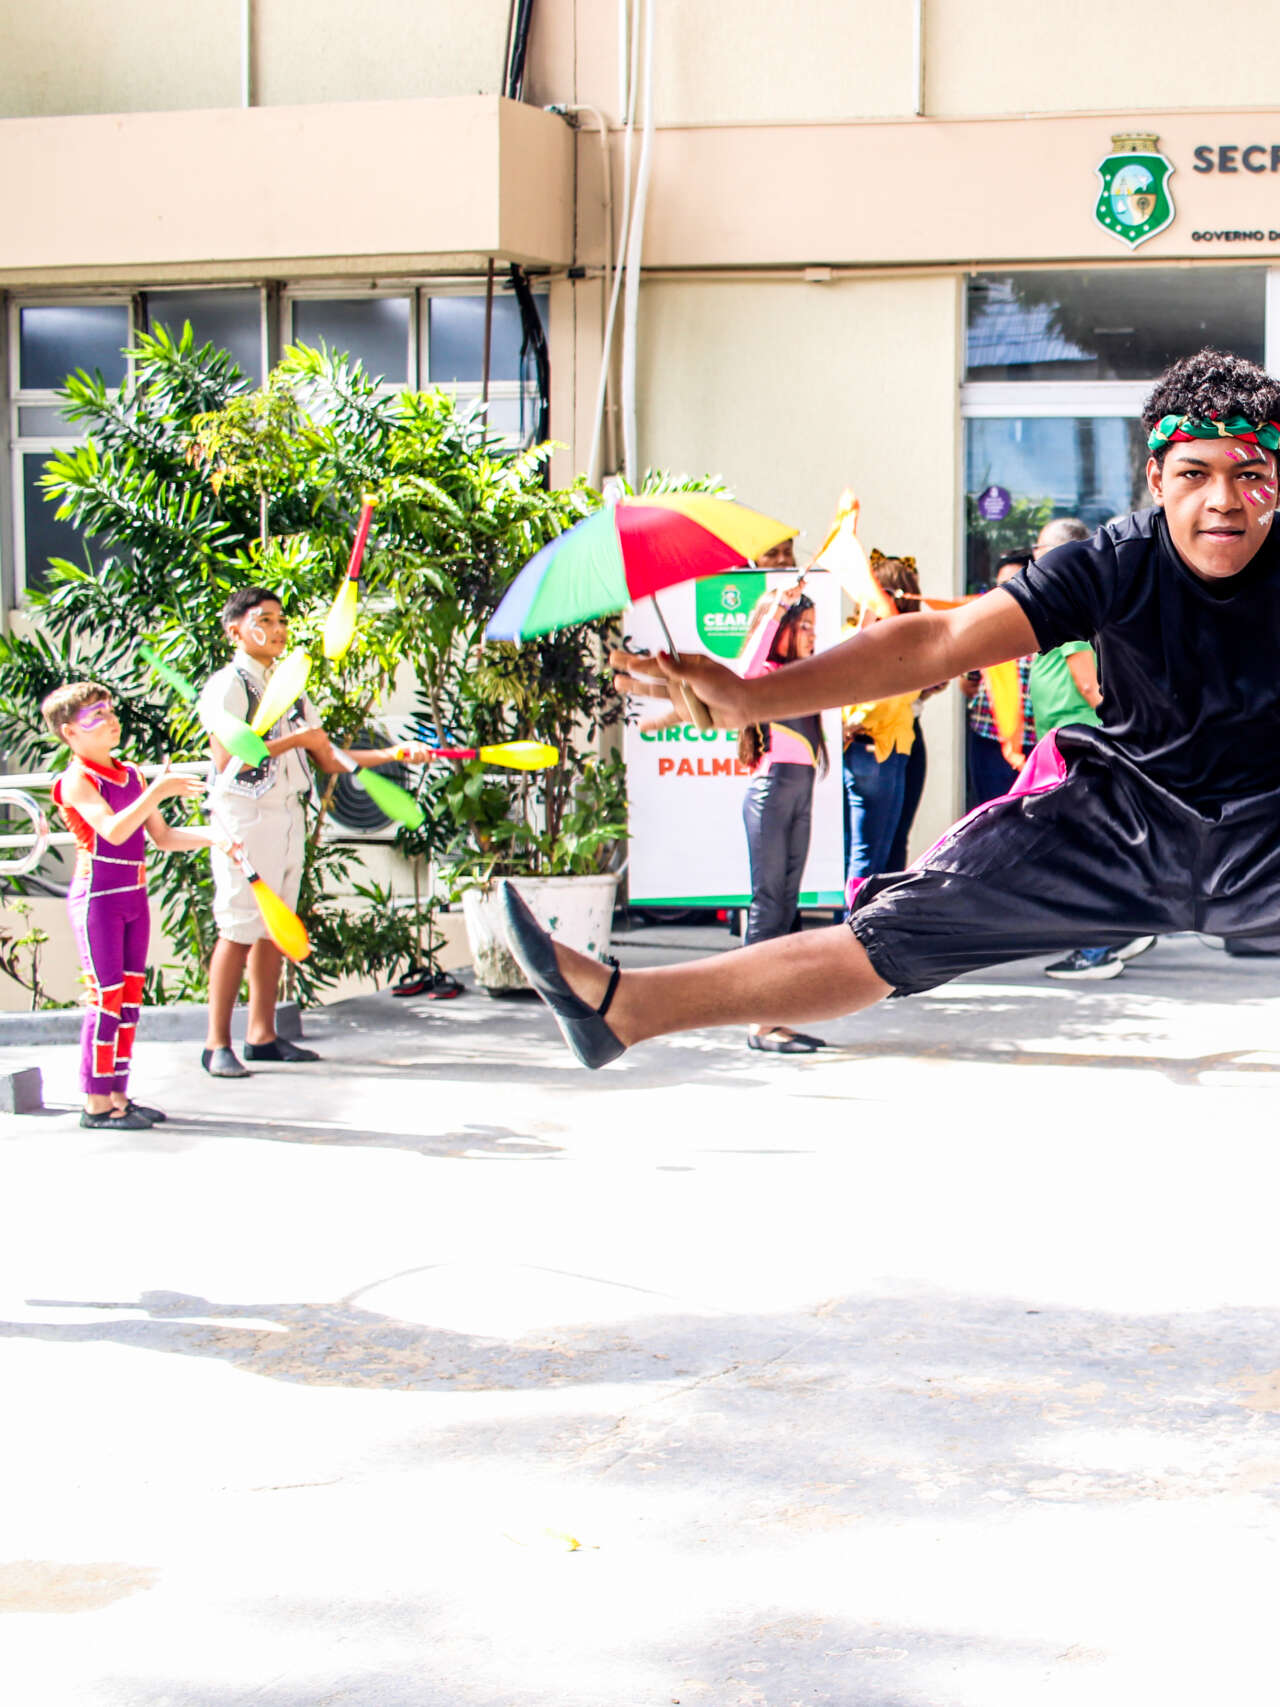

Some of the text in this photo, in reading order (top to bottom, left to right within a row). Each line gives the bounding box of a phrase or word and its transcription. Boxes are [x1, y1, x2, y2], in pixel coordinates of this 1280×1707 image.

[1191, 230, 1264, 242] GOVERNO
[640, 723, 718, 742] CIRCO
[658, 757, 754, 776] PALME
